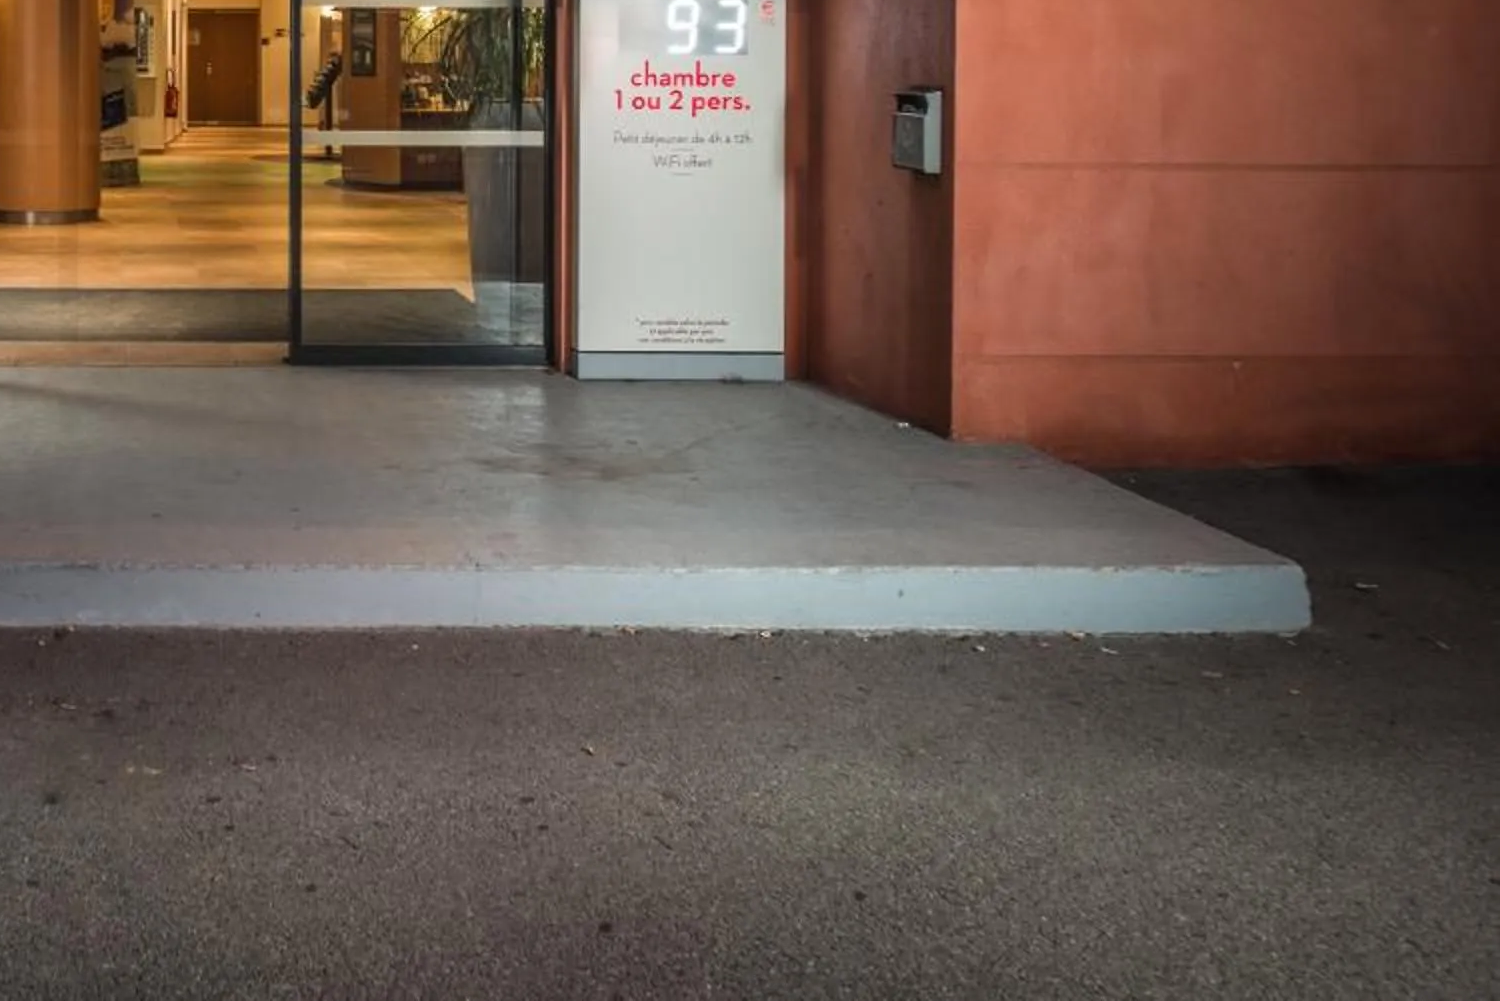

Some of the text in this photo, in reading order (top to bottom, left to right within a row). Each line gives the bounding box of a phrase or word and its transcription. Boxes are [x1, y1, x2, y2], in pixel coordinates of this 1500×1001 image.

[630, 60, 736, 87] chambre
[614, 90, 751, 117] 1 ou 2 pers.
